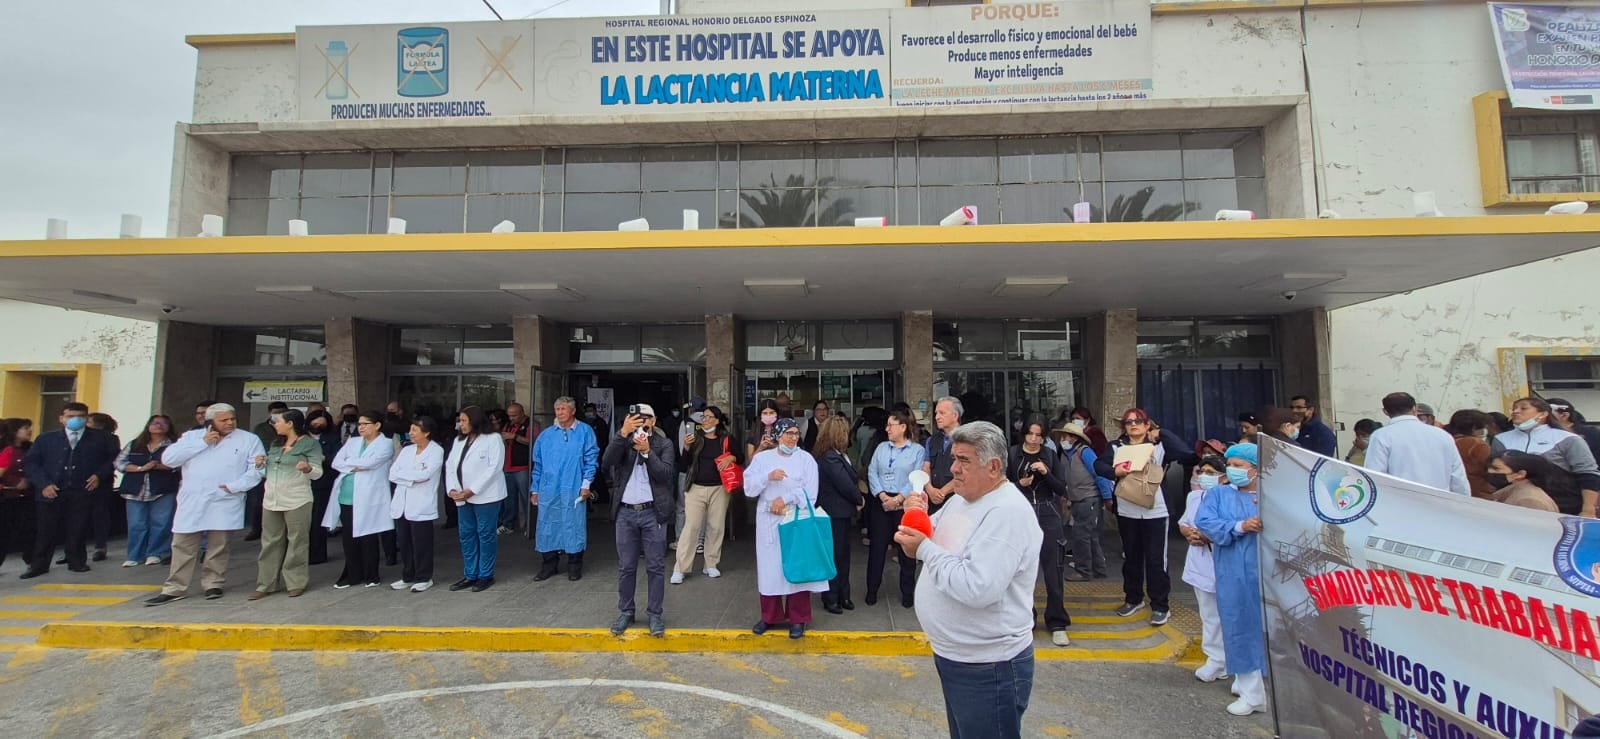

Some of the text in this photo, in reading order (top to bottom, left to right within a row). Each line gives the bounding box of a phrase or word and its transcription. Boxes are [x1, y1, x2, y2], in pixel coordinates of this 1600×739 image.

[605, 14, 816, 28] HOSPITAL REGIONAL HONORIO DELGADO ESPINOZA
[970, 4, 1060, 22] PORQUE:
[901, 23, 1138, 46] Favorece el desarrollo físico y emocional del bebé
[592, 28, 884, 63] EN ESTE HOSPITAL SE APOYA
[948, 44, 1092, 62] Produce menos enfermedades
[1528, 54, 1589, 66] HONORIO
[974, 63, 1064, 82] Mayor inteligencia
[600, 68, 884, 105] LA LACTANCIA MATERNA
[894, 78, 944, 86] RECUERDA:
[1111, 80, 1141, 90] MESES
[331, 104, 378, 120] PRODUCEN
[379, 102, 415, 119] MUCHAS
[1304, 568, 1600, 662] SINDICATO DE TRABAJA
[1338, 626, 1446, 704] TÉCNICOS
[1453, 680, 1471, 715] Y
[1298, 641, 1481, 739] HOSPITAL REGIO
